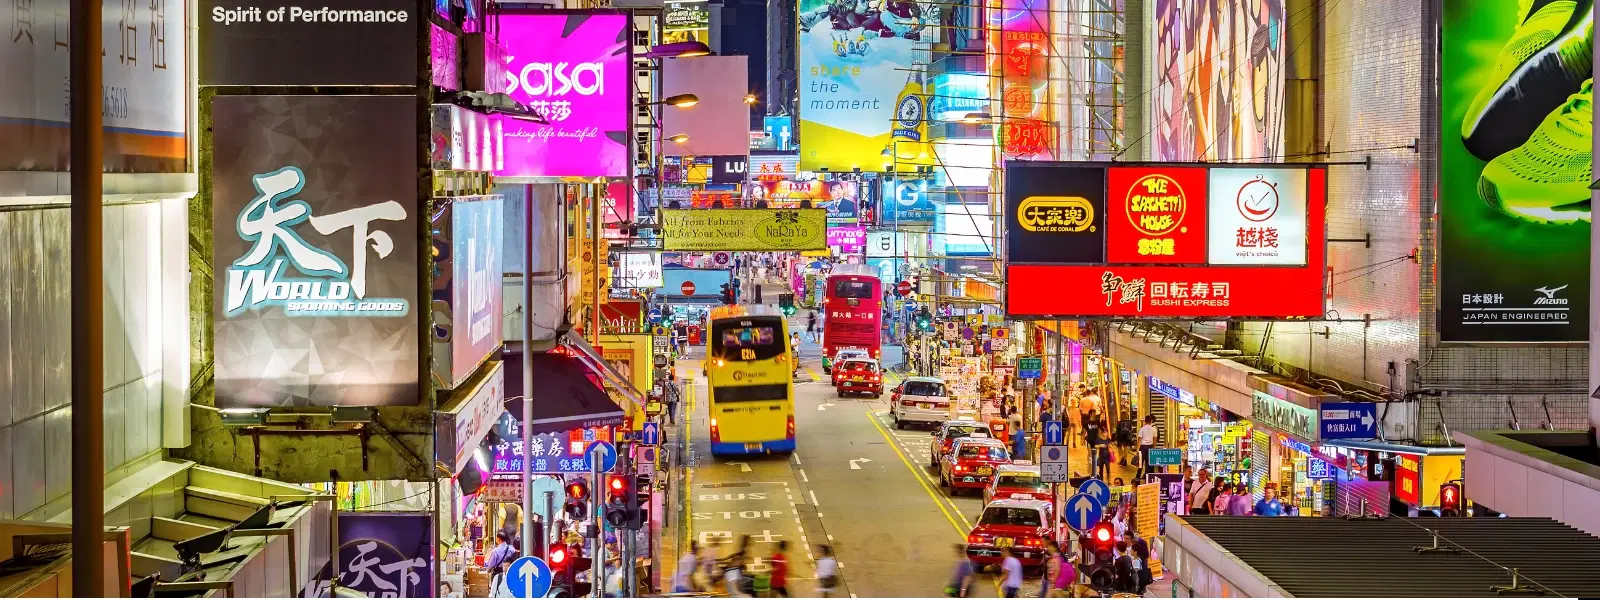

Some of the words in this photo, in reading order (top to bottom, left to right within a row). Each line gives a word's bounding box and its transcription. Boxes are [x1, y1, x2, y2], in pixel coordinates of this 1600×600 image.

[212, 7, 261, 25] Spirit
[267, 7, 285, 22] of
[290, 7, 408, 23] Performance
[810, 64, 861, 76] share
[810, 81, 839, 93] the
[810, 97, 880, 110] moment
[503, 127, 537, 143] making
[537, 127, 556, 142] life
[557, 127, 598, 142] beautiful
[1142, 178, 1168, 194] THE
[680, 216, 704, 227] from
[707, 217, 745, 226] Fabrics
[1140, 213, 1174, 231] HOUSE
[236, 168, 408, 300] 天下
[692, 229, 713, 238] Your
[716, 229, 745, 238] Needs
[766, 225, 808, 238] NaRaYa
[1236, 227, 1279, 248] 越棧
[1150, 299, 1180, 307] SUSHI
[1183, 299, 1230, 307] EXPRESS
[1462, 294, 1504, 304] 日本設計
[358, 302, 403, 311] GOODS
[699, 493, 767, 501] BUS
[692, 510, 783, 520] STOP
[348, 541, 427, 598] 天下
